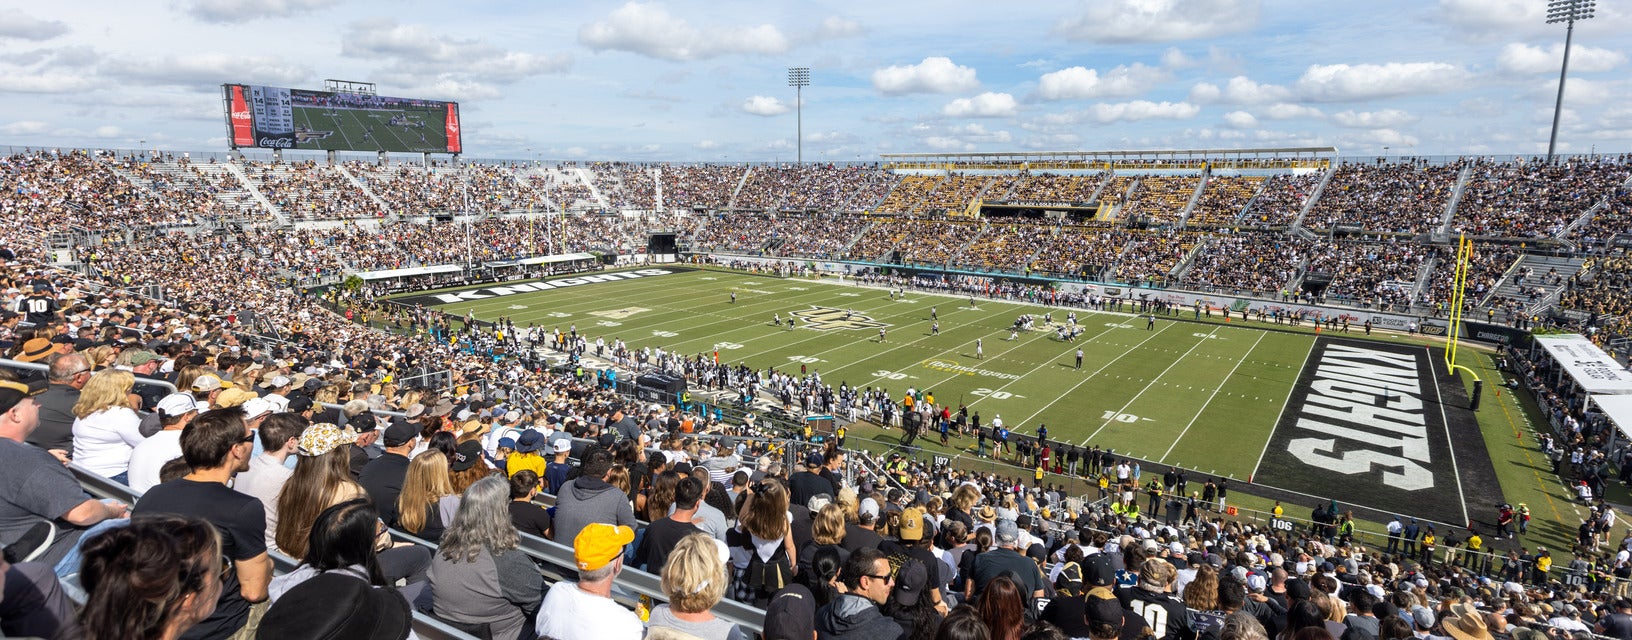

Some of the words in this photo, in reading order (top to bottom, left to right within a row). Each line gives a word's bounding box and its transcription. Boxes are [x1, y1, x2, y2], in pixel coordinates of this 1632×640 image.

[434, 268, 672, 303] KNIGHTS
[27, 299, 47, 312] 10
[871, 370, 908, 380] 30
[970, 388, 1012, 400] 20
[1100, 410, 1139, 423] 10
[1286, 344, 1434, 491] KNIGHTS
[935, 456, 948, 465] 107
[1272, 518, 1293, 531] 106
